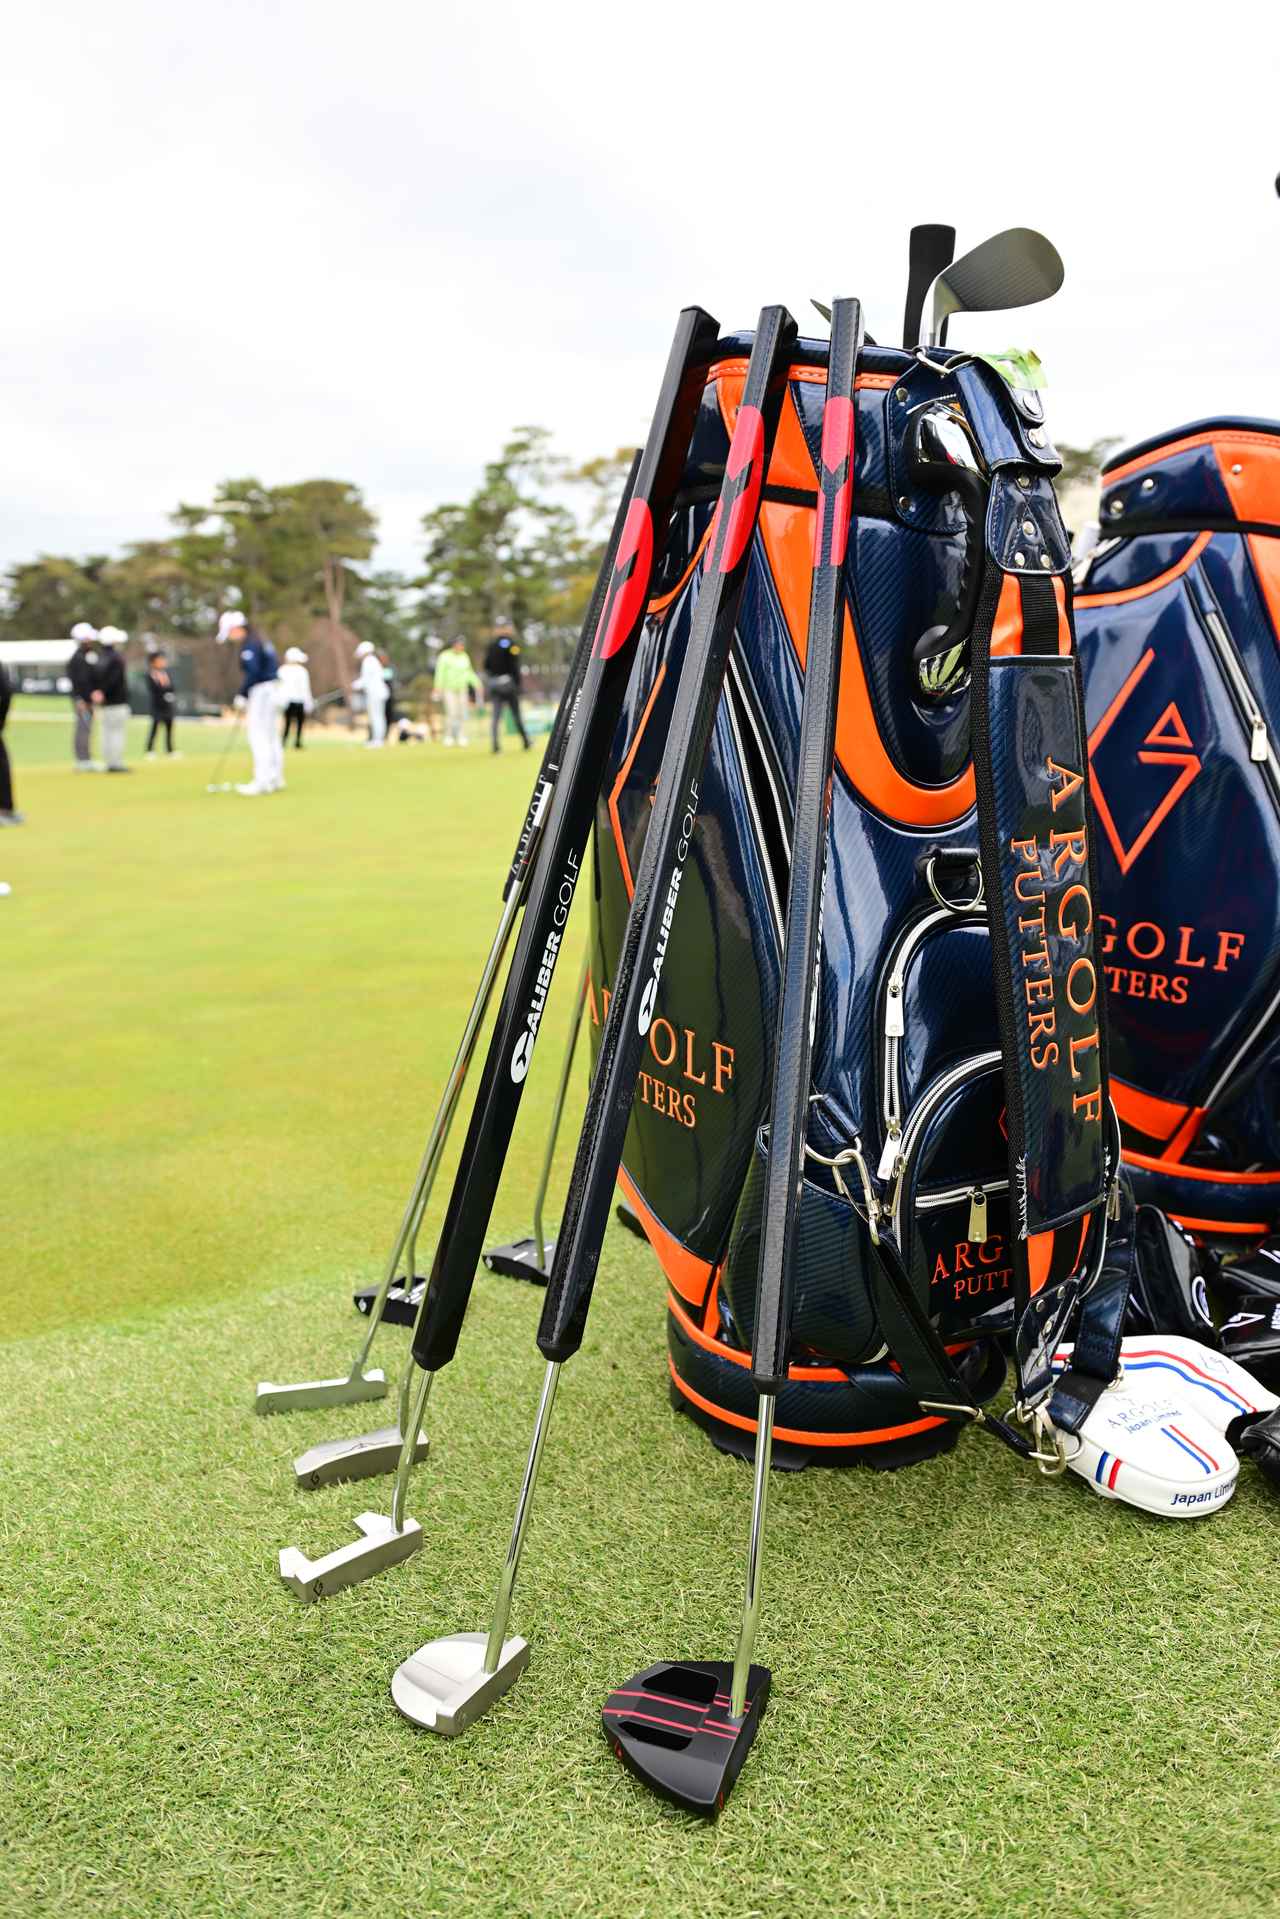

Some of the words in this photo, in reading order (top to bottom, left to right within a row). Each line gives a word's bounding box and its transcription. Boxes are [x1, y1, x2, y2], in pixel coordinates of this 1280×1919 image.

[638, 866, 683, 1037] CALIBER
[677, 777, 701, 863] GOLF
[510, 930, 561, 1084] CALIBER
[553, 847, 581, 927] GOLF
[1011, 834, 1060, 1070] PUTTERS
[1047, 756, 1102, 1122] ARGOLF
[1098, 914, 1245, 973] GOLF
[1103, 965, 1189, 1005] TERS
[638, 1071, 696, 1128] TERS
[930, 1234, 1004, 1285] ARG
[953, 1267, 1014, 1301] PUTT
[1170, 1491, 1212, 1507] Japan
